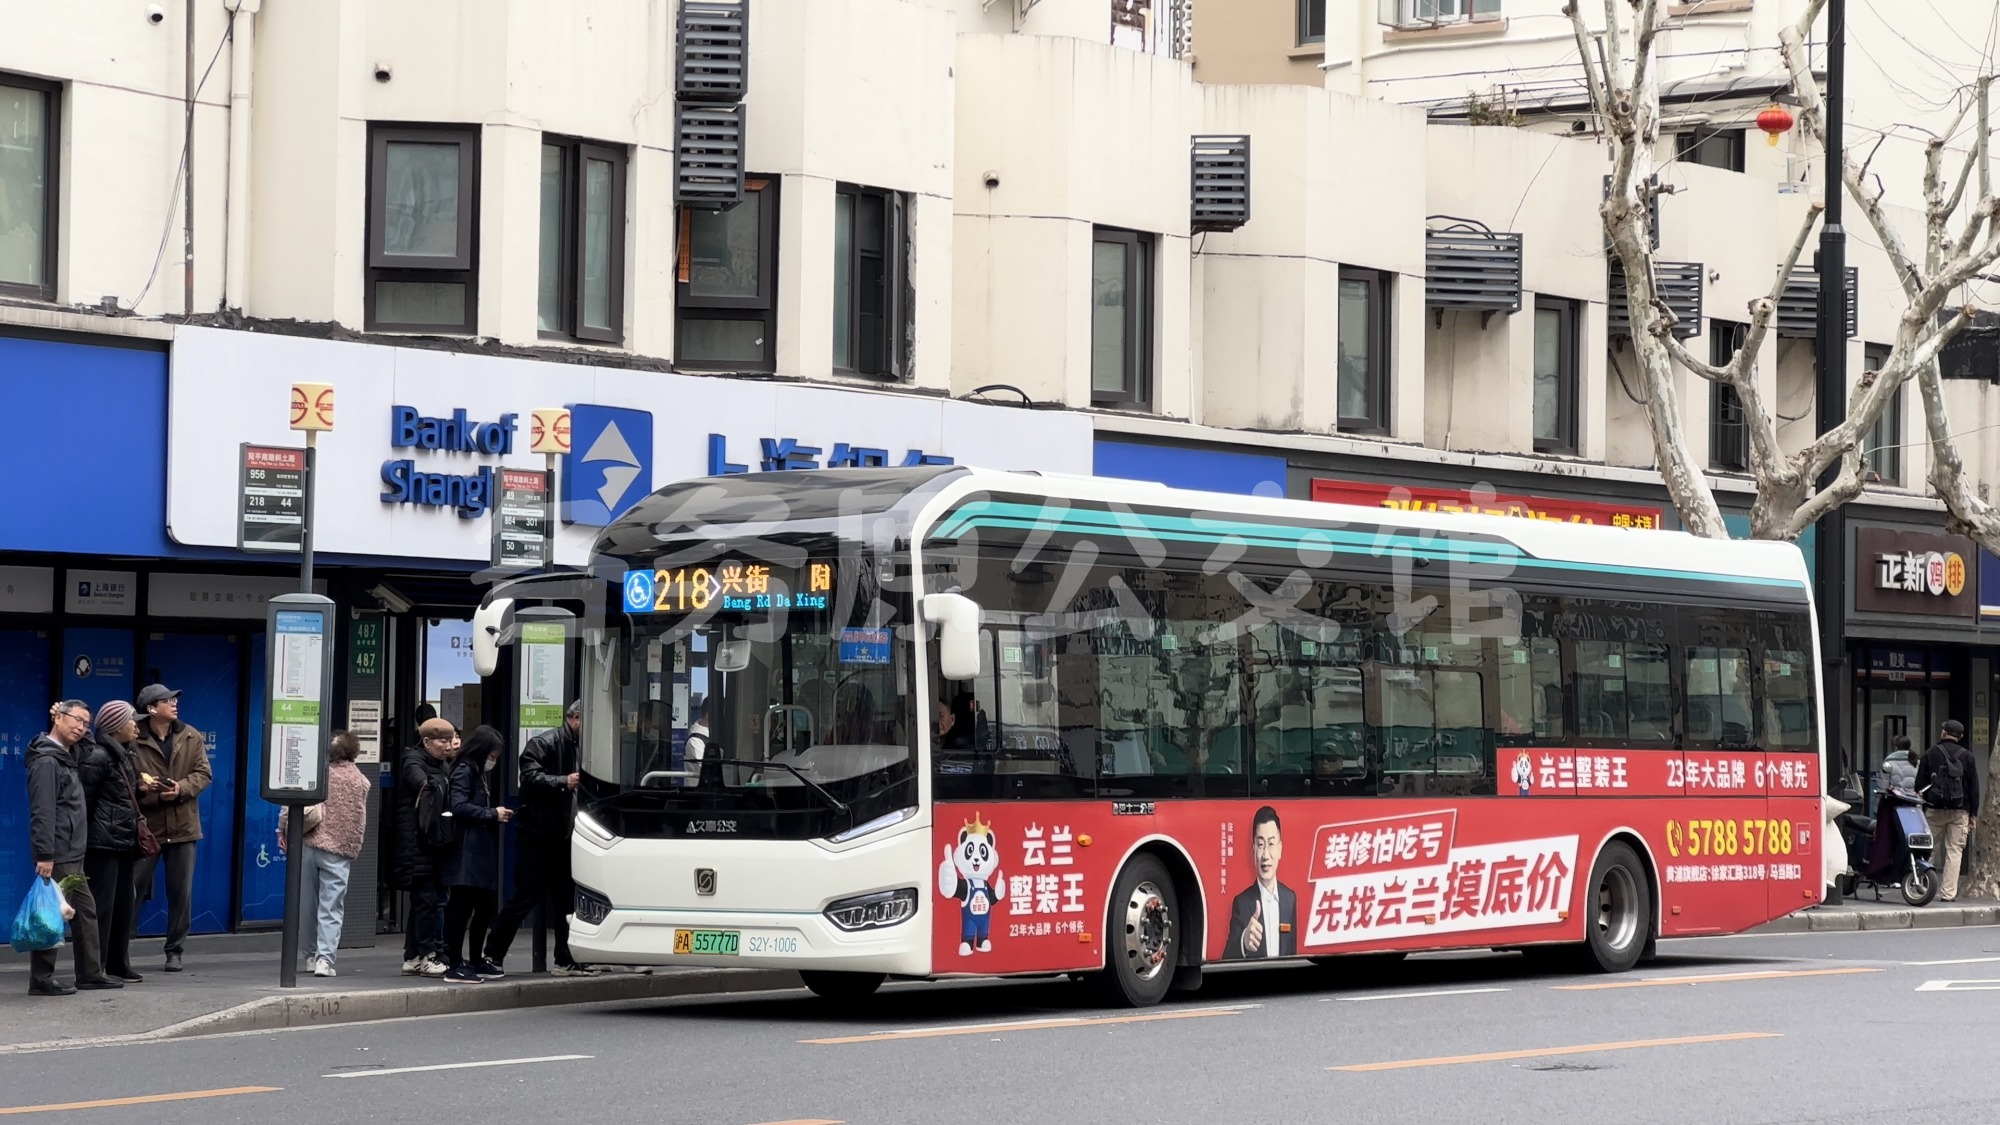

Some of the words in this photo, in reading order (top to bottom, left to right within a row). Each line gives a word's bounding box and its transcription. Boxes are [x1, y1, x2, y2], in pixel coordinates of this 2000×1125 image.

[392, 405, 478, 452] Bank
[477, 413, 518, 454] of
[250, 469, 265, 480] 956
[249, 496, 265, 506] 218
[280, 498, 292, 507] 44
[525, 517, 538, 527] 301
[506, 541, 515, 551] 50
[722, 565, 770, 594] 兴街
[1876, 550, 1964, 595] 正新鸡排
[654, 568, 711, 611] 218
[723, 595, 752, 611] Bang
[757, 594, 771, 608] Rd
[776, 594, 792, 608] Da
[796, 592, 826, 609] Xing
[357, 624, 376, 638] 487
[356, 652, 376, 667] 487
[280, 703, 292, 712] 44
[525, 708, 536, 716] 89
[1539, 752, 1629, 789] 云兰整装王
[1666, 758, 1746, 789] 23年大品牌
[1754, 760, 1808, 789] 6个领先
[1022, 822, 1074, 867] 云兰
[1323, 822, 1444, 870] 装修怕吃亏
[1688, 819, 1738, 856] 5788
[1743, 818, 1792, 855] 5788
[1009, 873, 1085, 915] 整装王
[1312, 851, 1570, 935] 先找云兰摸底价
[1009, 922, 1051, 937] 23年大品牌
[1055, 920, 1085, 934] 6个领先
[749, 937, 797, 952] S2Y-1006
